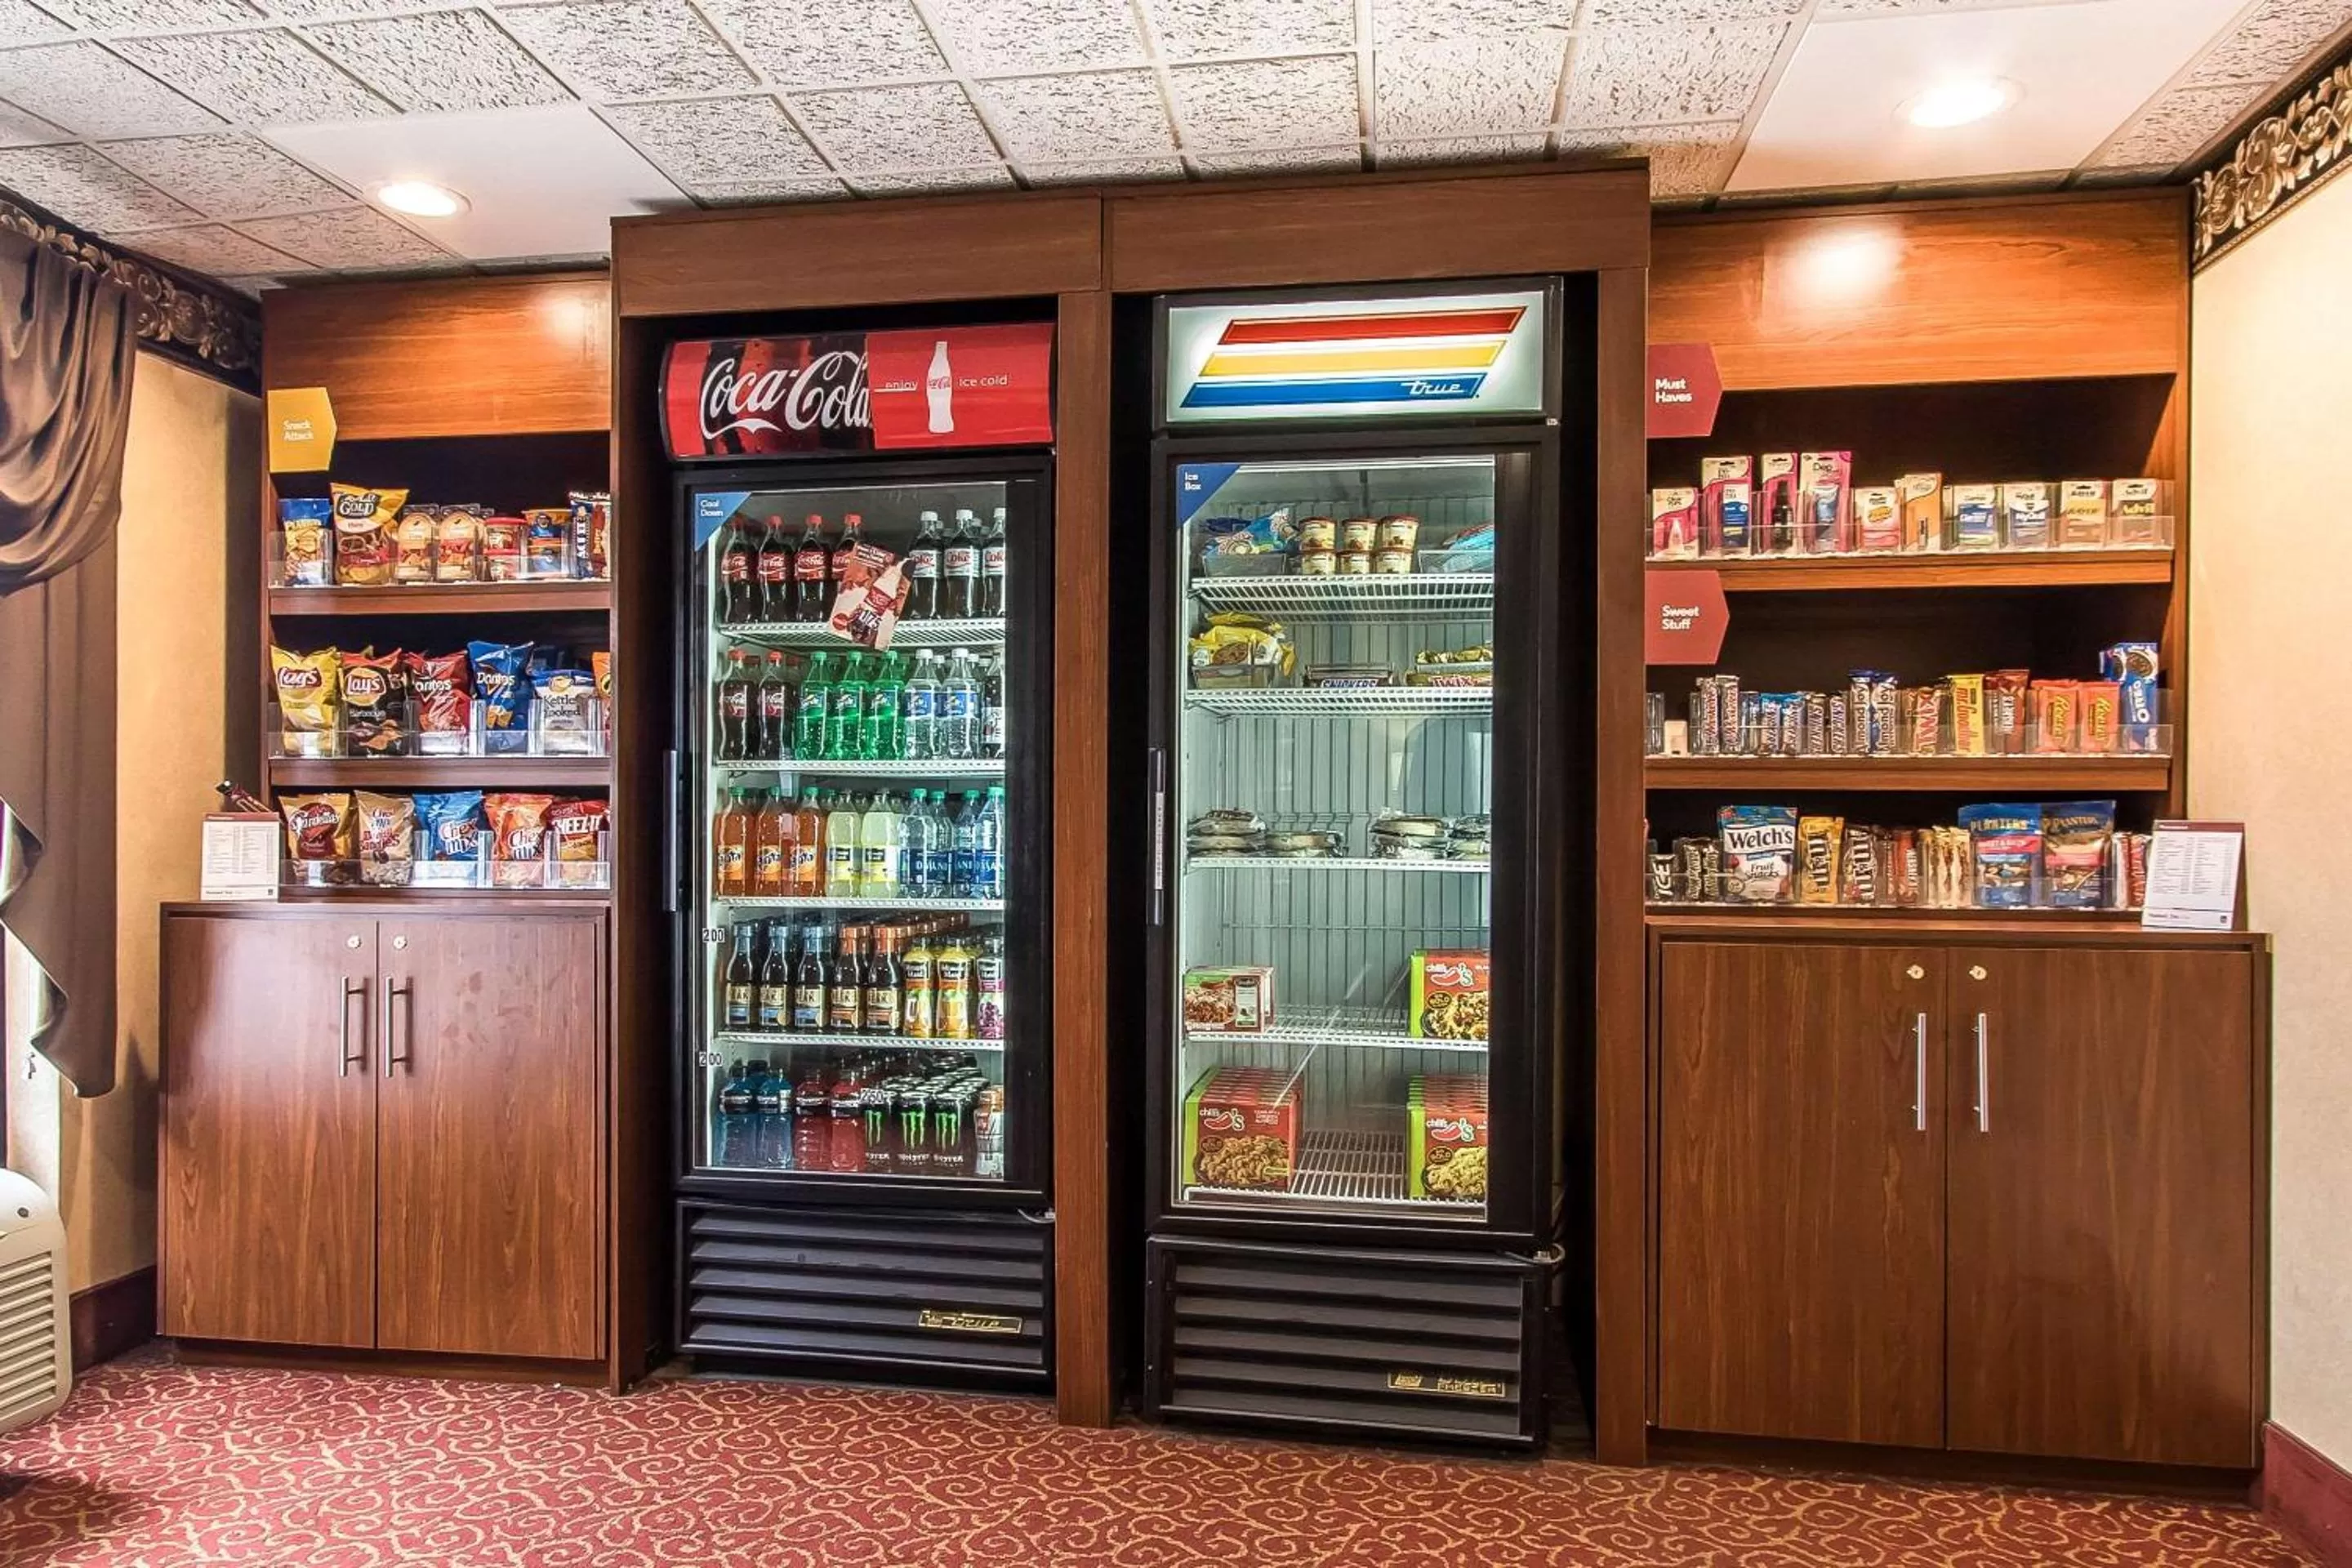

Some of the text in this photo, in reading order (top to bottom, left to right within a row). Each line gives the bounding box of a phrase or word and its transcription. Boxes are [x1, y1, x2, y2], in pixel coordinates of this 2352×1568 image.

[885, 379, 918, 390] enjoy
[959, 375, 1008, 387] ice cold
[1655, 378, 1686, 390] Must
[700, 351, 872, 439] Coca-Cola
[1655, 392, 1692, 403] Haves
[283, 419, 312, 430] Snack
[284, 430, 314, 441] Attack
[1185, 471, 1198, 480] Ice
[1185, 481, 1201, 490] Box
[340, 501, 375, 514] GOLD
[700, 499, 719, 507] Cool
[701, 508, 724, 516] Down
[1662, 604, 1699, 617] Sweet
[1662, 618, 1691, 630] Stuff
[278, 667, 318, 688] Lay's
[476, 671, 516, 687] Doritos
[346, 675, 381, 695] Lay's
[415, 679, 452, 693] oritos
[1877, 684, 1891, 706] Joy
[1853, 685, 1868, 752] Almond Joy
[1726, 827, 1793, 849] Welch's
[1750, 862, 1775, 872] Fruit
